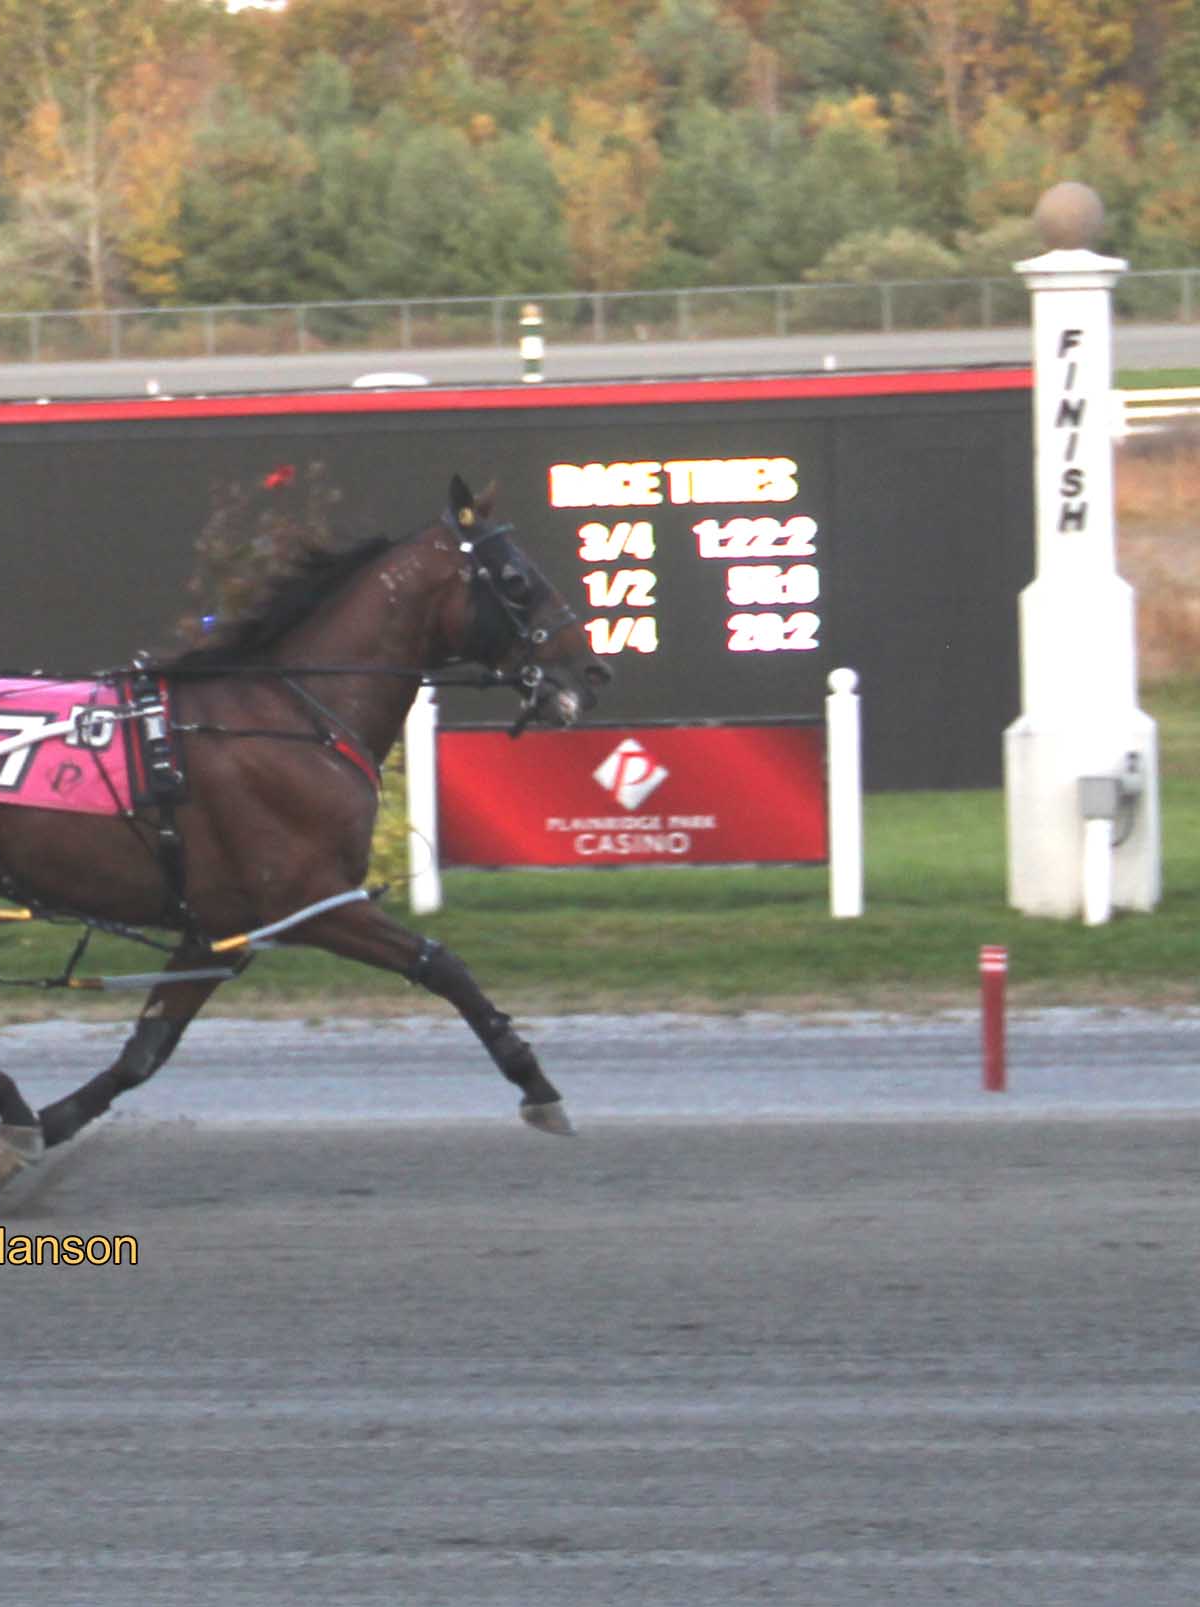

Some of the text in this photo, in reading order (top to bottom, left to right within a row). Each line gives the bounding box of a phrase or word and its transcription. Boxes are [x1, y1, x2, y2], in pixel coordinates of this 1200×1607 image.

[1057, 329, 1088, 532] FINISH
[549, 457, 799, 508] RACE TIMES
[578, 521, 656, 562] 3/4
[582, 569, 657, 607] 1/2
[584, 616, 659, 654] 1/4
[546, 815, 716, 831] PLAINRIDGE PARK
[574, 832, 691, 855] CASINO
